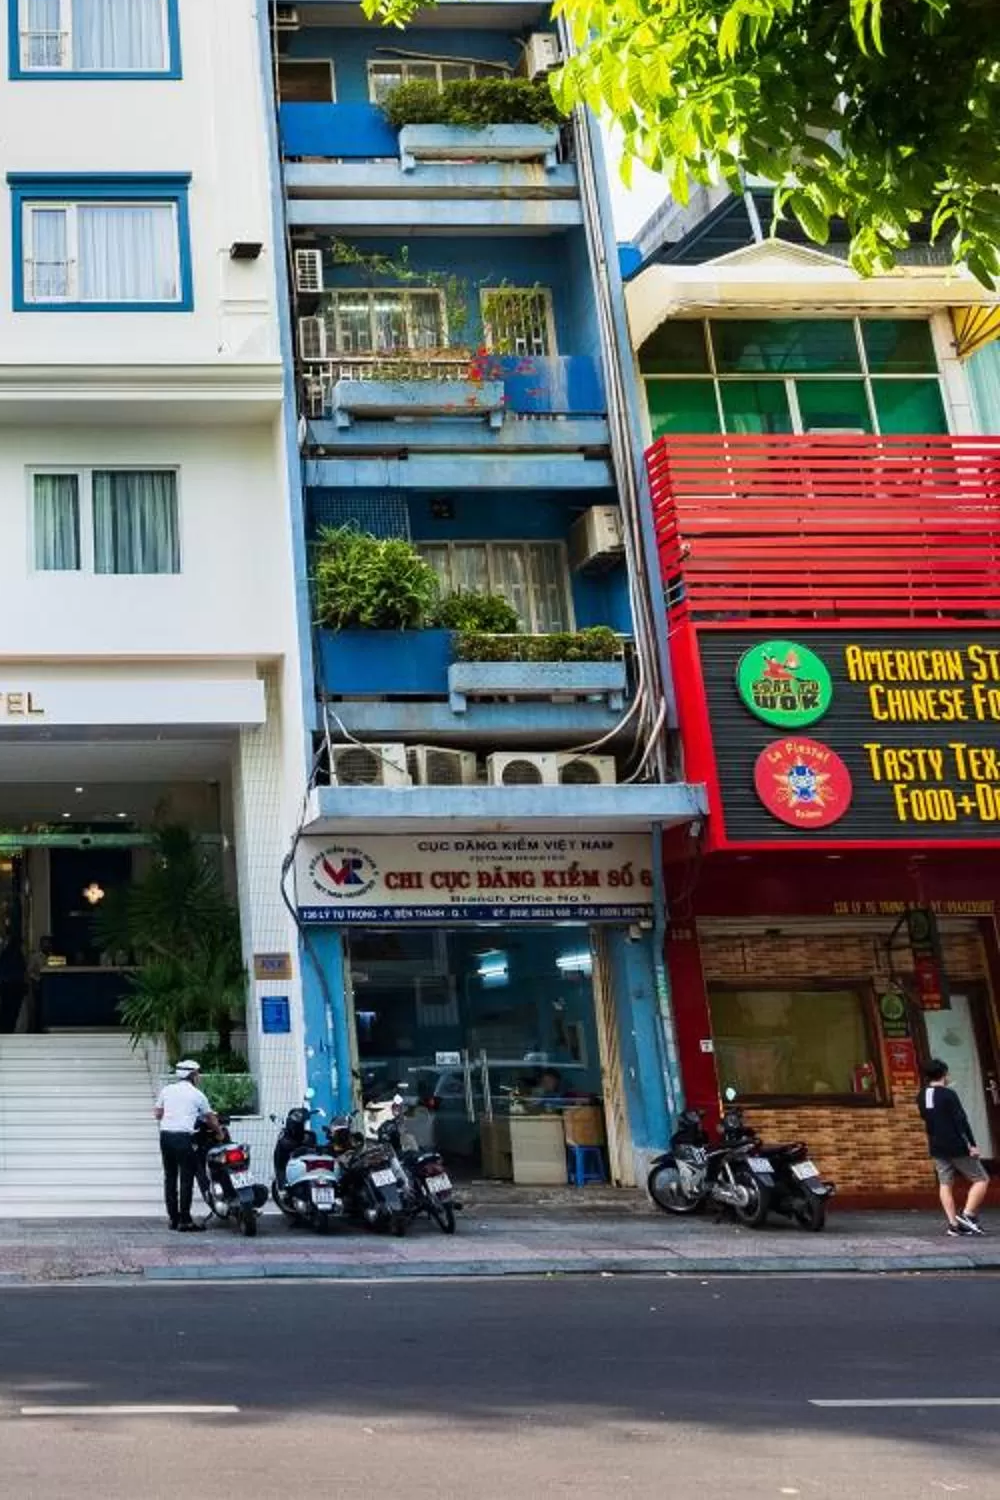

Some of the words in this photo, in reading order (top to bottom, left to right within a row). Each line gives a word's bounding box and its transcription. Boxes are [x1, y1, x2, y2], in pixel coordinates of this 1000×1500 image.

[845, 644, 965, 681] AMERICAN
[754, 693, 820, 711] WOK
[869, 683, 969, 721] CHINESE
[863, 743, 944, 781] TASTY
[580, 841, 614, 850] NAM
[384, 871, 423, 890] CHI
[430, 871, 471, 893] CỤC
[477, 865, 536, 889] ĐĂNG
[542, 861, 600, 888] KIỂM
[607, 862, 634, 887] SỐ
[640, 869, 653, 887] 6
